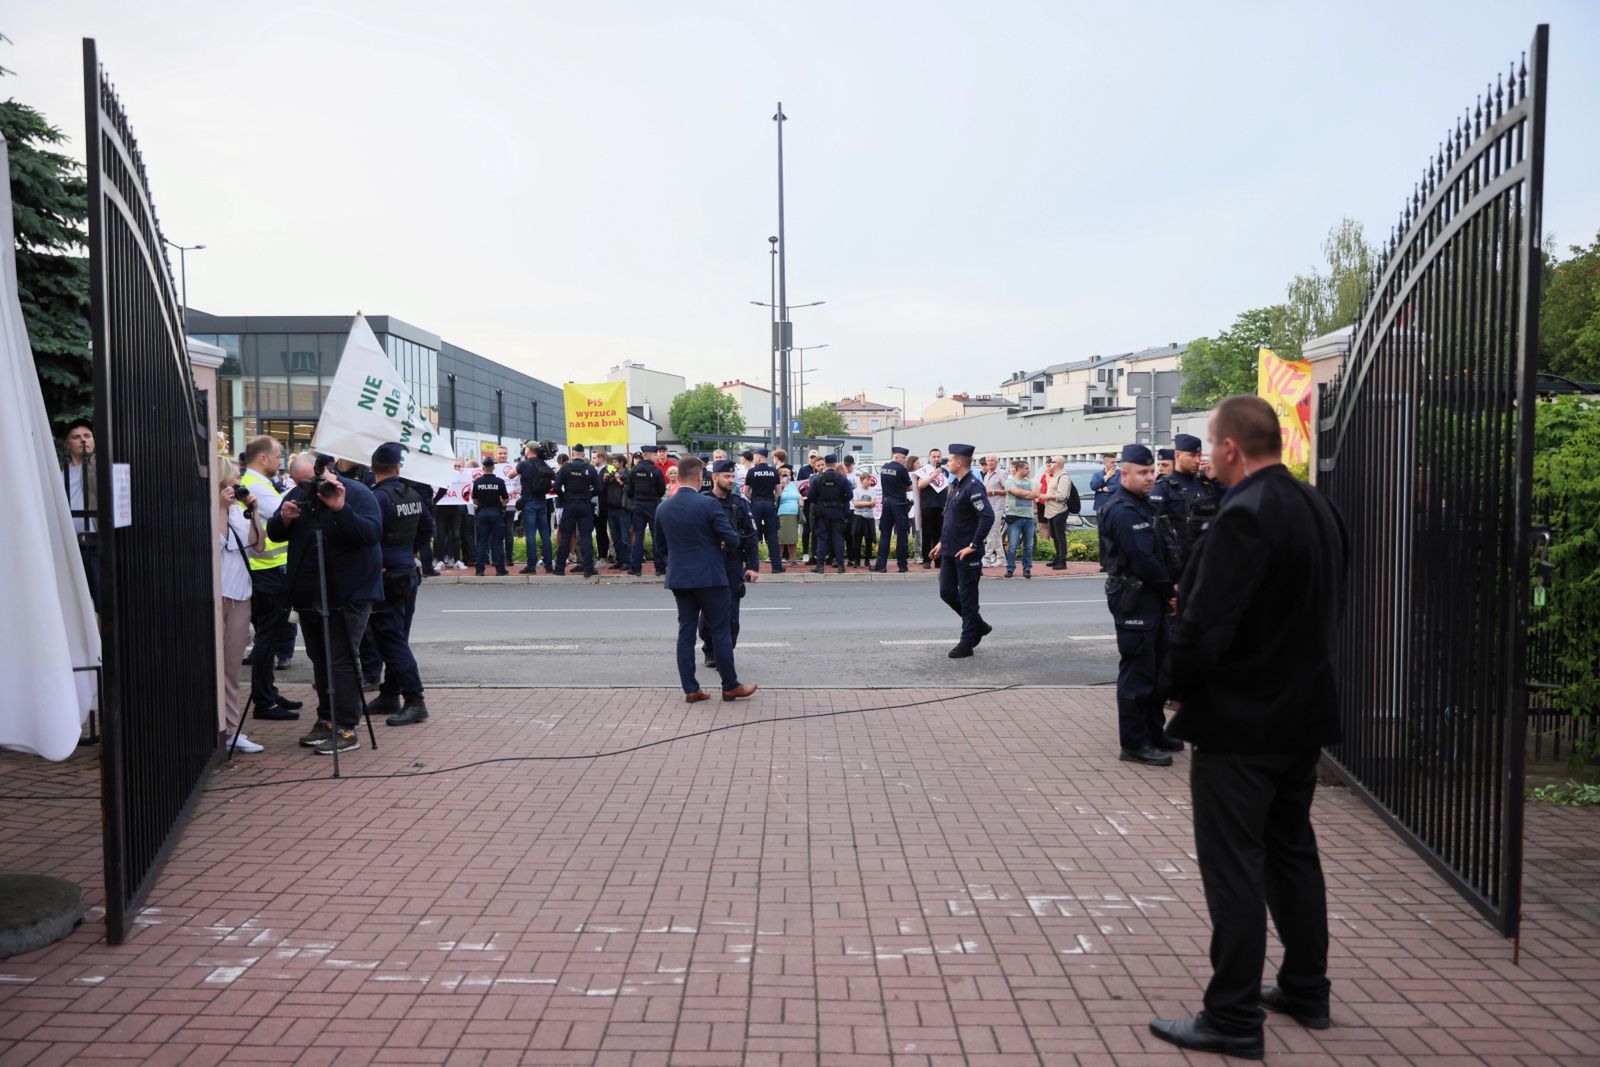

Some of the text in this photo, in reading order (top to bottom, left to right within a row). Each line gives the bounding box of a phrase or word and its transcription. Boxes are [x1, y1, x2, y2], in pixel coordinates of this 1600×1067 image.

[357, 375, 383, 411] NIE
[383, 388, 401, 418] dla
[576, 409, 616, 419] wyrzuca
[602, 418, 625, 427] bruk
[793, 421, 798, 430] P
[881, 467, 897, 476] POLICJA
[397, 502, 423, 517] POLICJA
[1132, 521, 1151, 531] POLICJA
